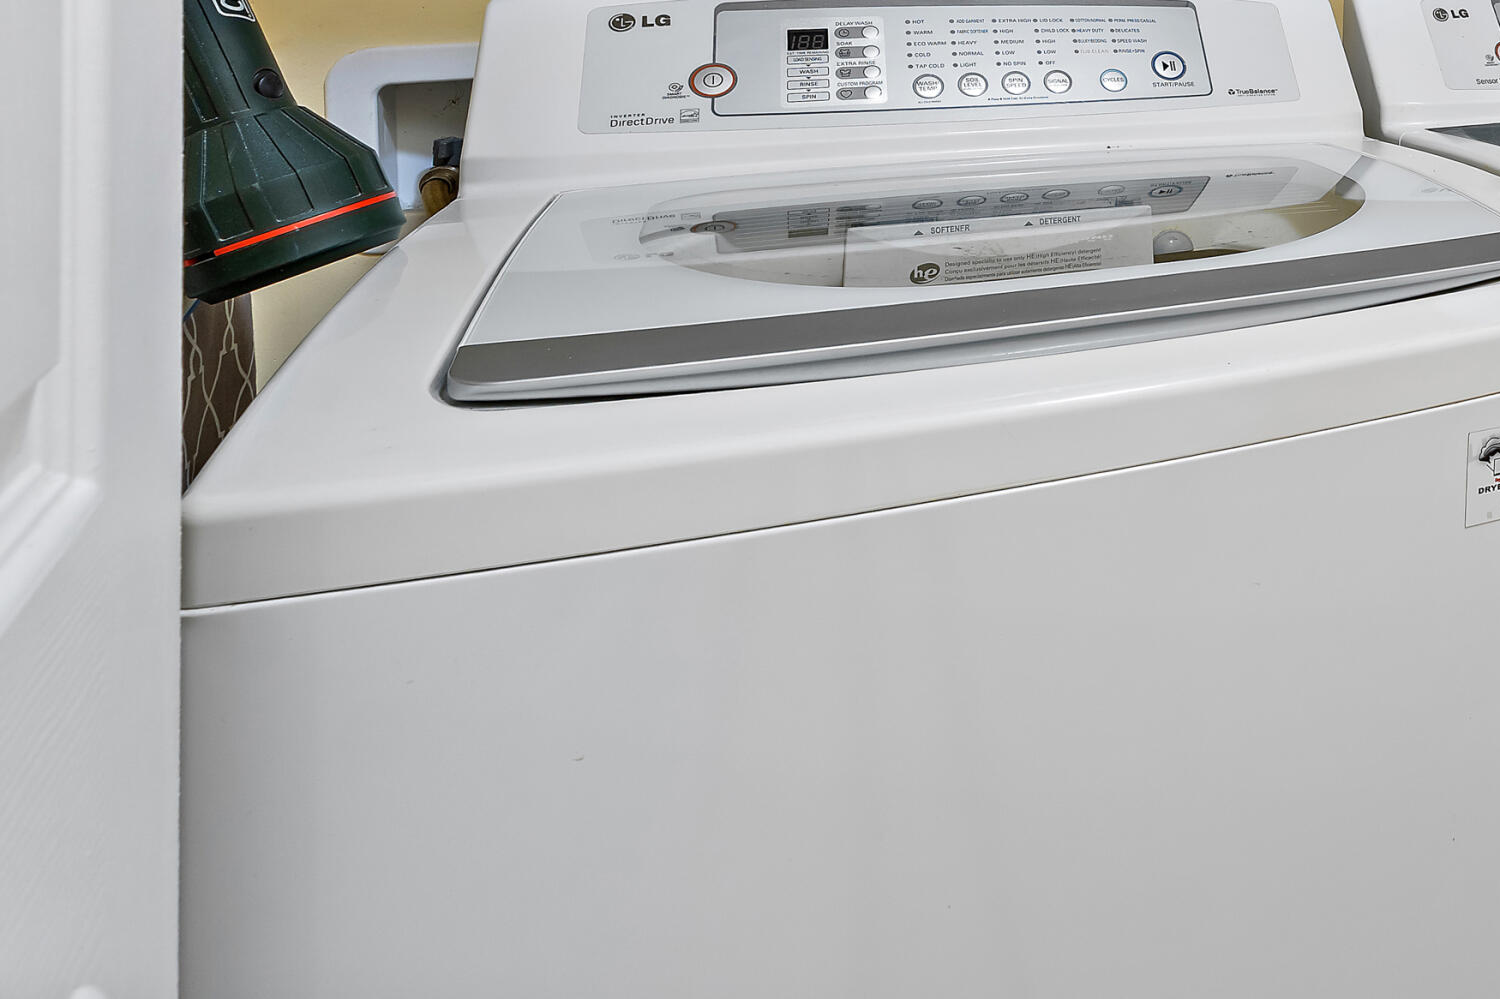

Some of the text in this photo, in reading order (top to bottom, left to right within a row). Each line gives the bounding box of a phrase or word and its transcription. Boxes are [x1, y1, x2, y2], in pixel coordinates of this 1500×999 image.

[641, 14, 671, 27] LG
[1450, 8, 1469, 19] LG
[791, 34, 825, 50] 188
[1102, 76, 1125, 84] CYCLES
[930, 215, 1081, 235] SOFTENER DETERGENT
[913, 263, 939, 282] he
